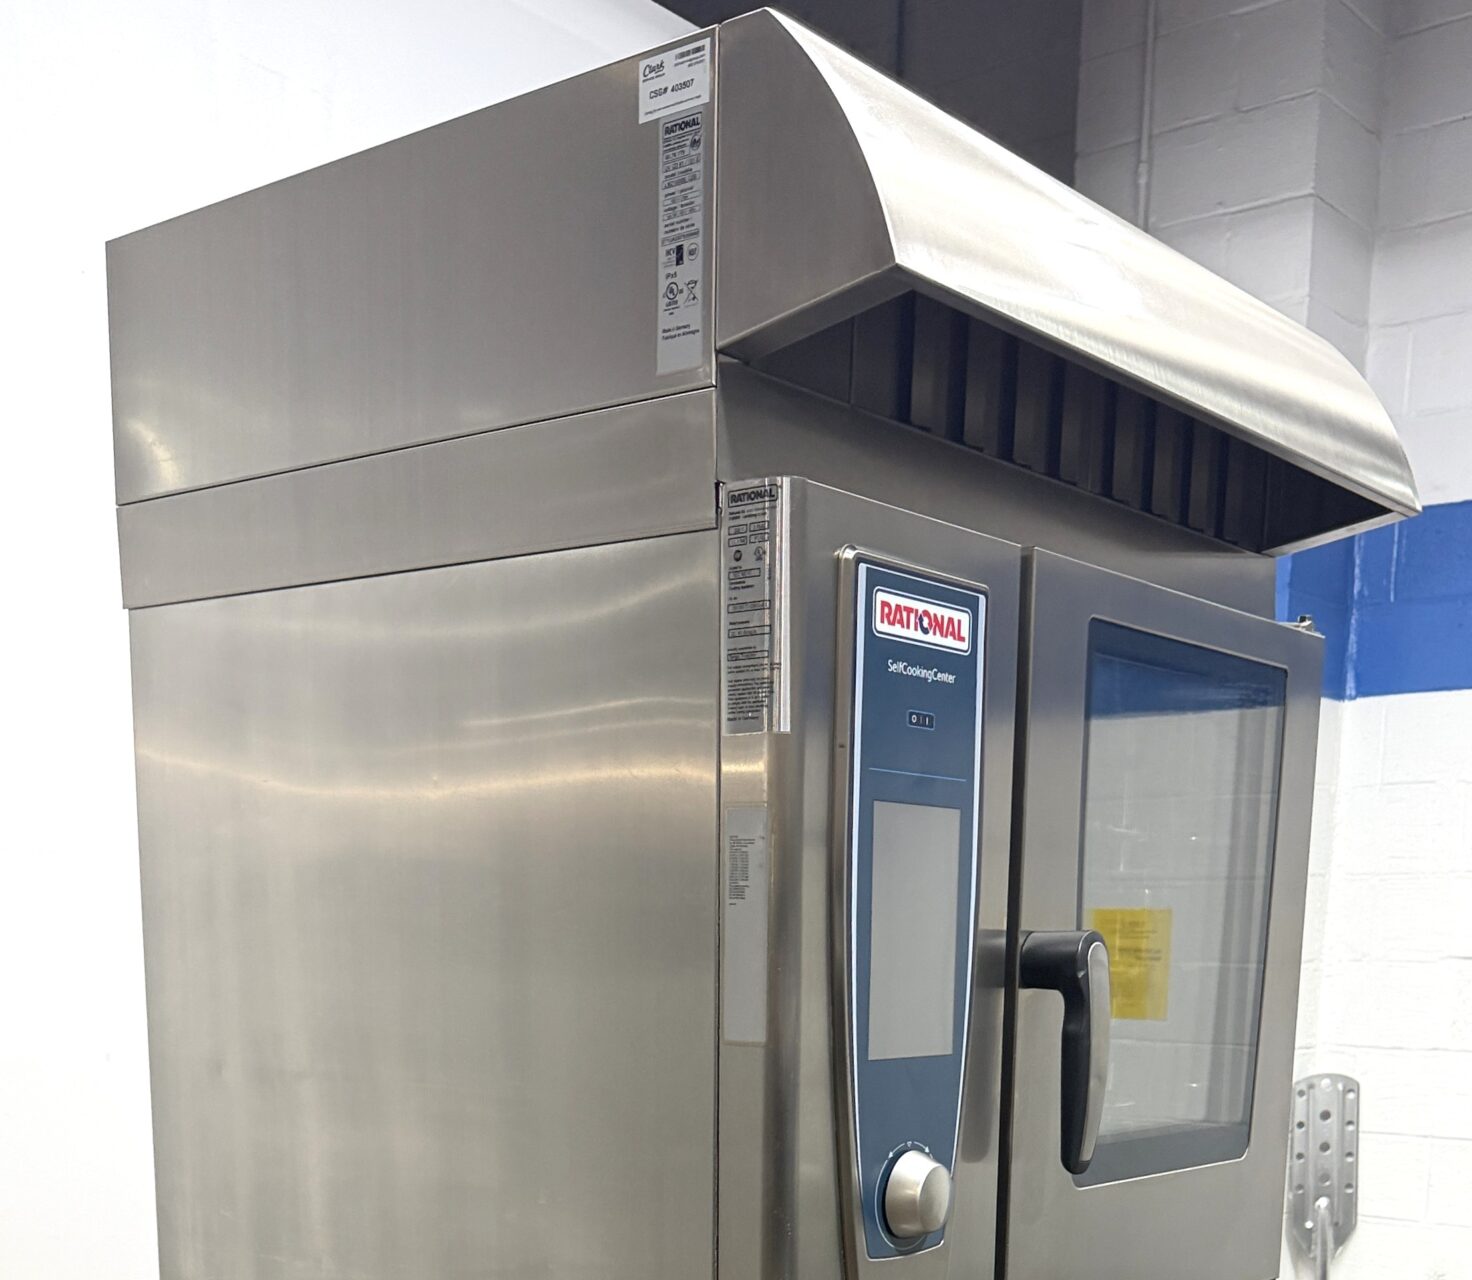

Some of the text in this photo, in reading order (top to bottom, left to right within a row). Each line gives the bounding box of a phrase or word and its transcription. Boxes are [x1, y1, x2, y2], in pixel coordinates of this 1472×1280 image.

[664, 116, 701, 136] RATIONAL
[730, 488, 776, 504] RATIONAL
[880, 600, 966, 643] RATIONAL
[887, 659, 957, 684] SelfCookingCenter
